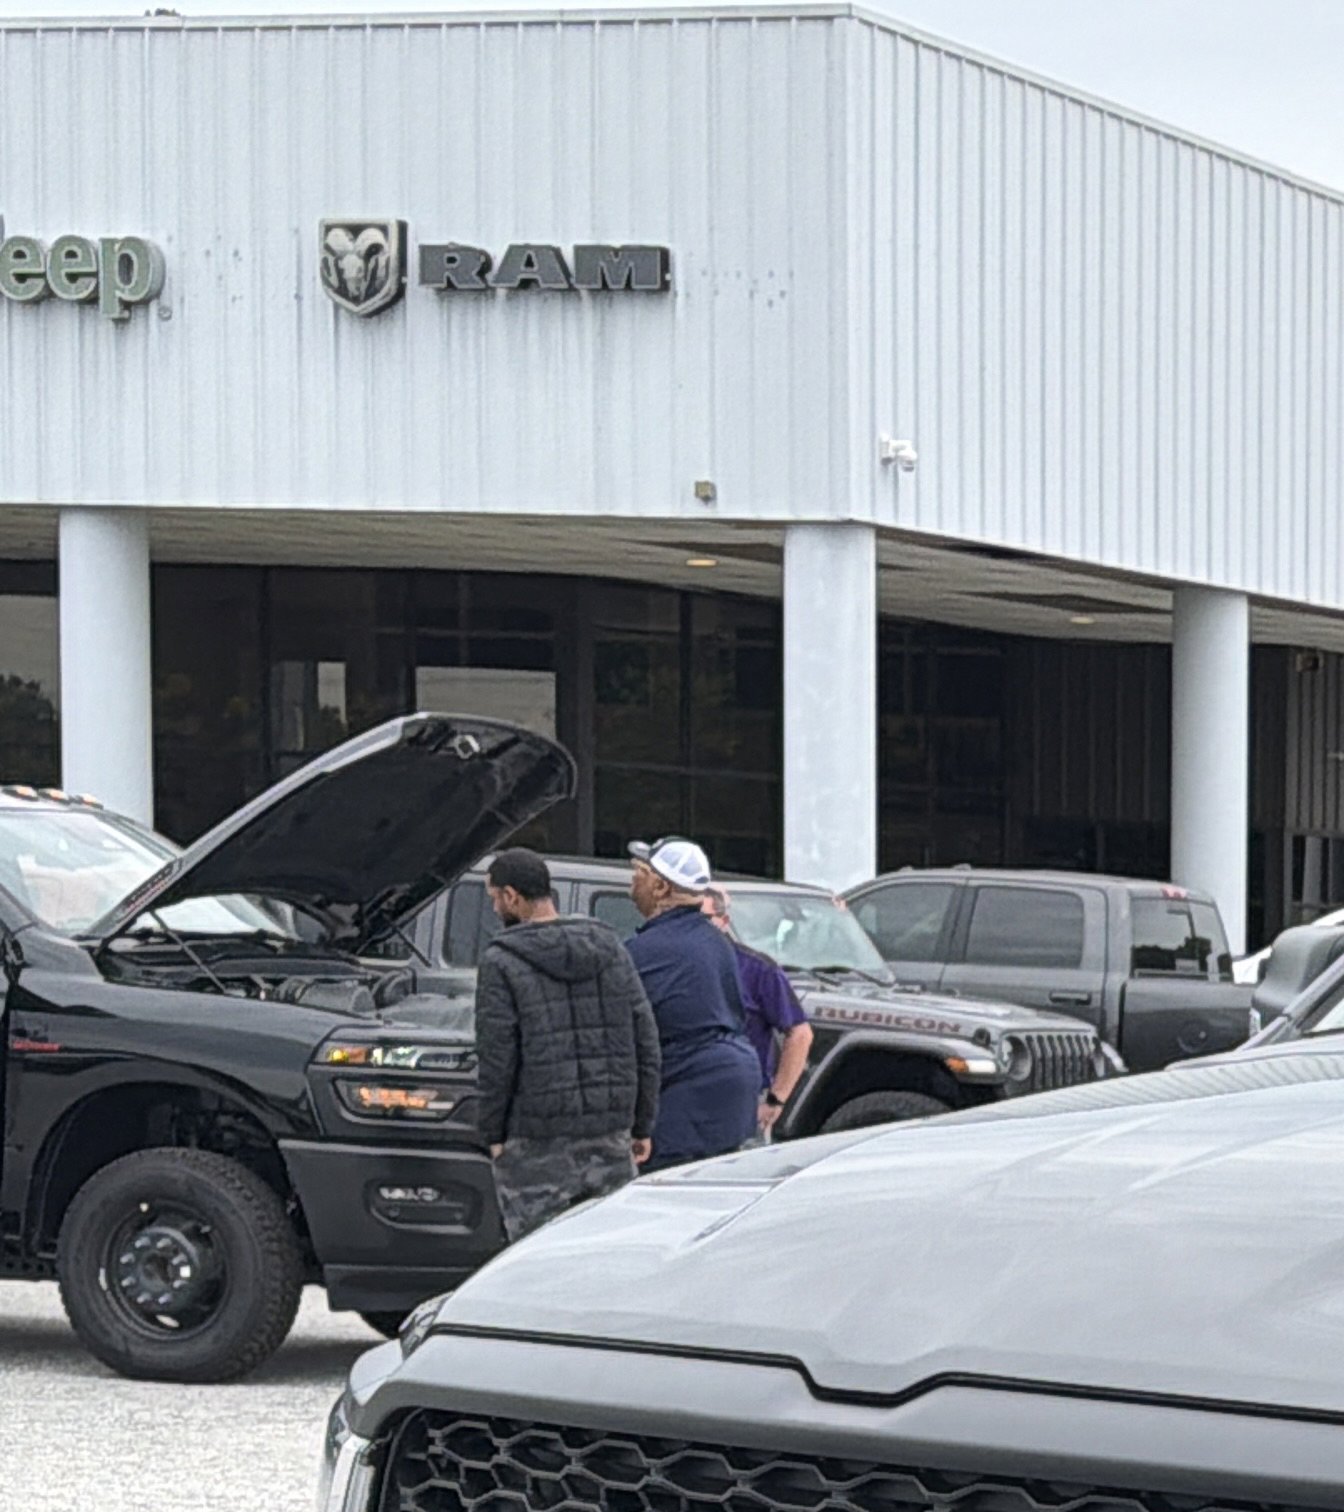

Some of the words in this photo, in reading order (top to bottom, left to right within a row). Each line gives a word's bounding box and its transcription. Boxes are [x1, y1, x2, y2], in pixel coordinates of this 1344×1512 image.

[0, 213, 166, 320] eep
[417, 242, 671, 291] RAM
[815, 1006, 962, 1033] RUBICON
